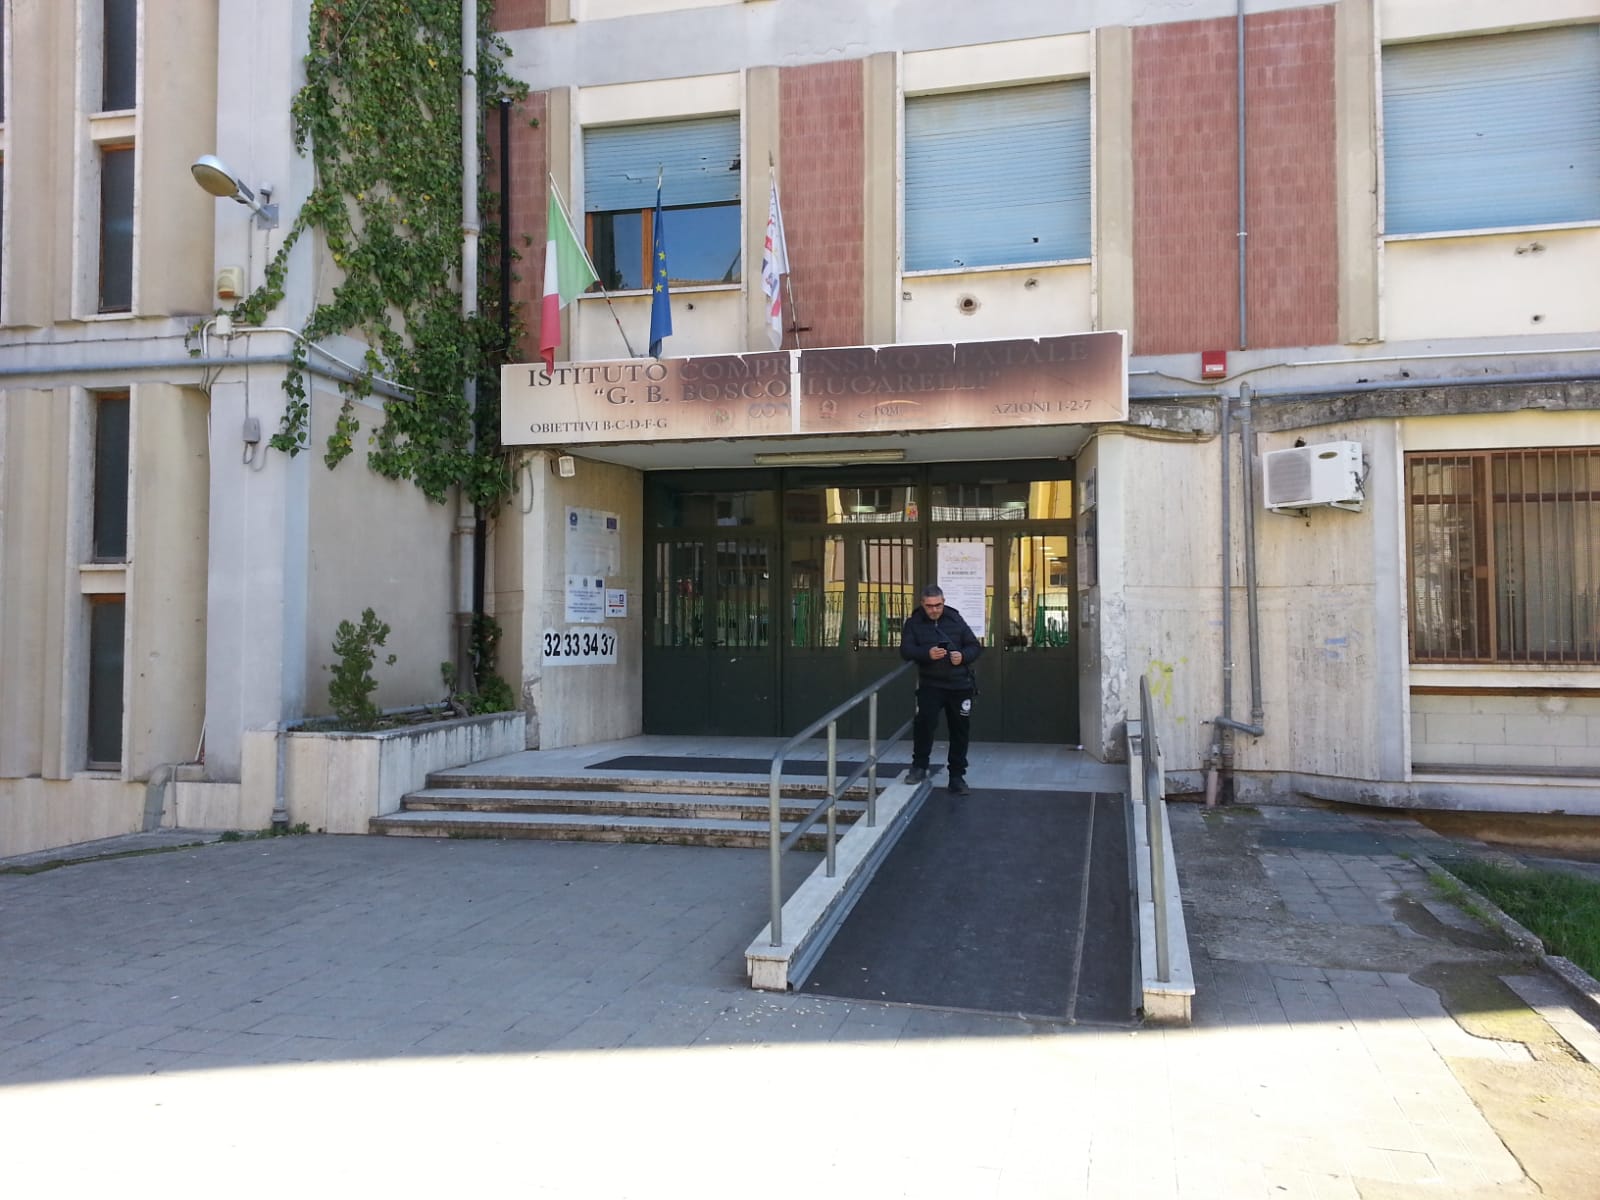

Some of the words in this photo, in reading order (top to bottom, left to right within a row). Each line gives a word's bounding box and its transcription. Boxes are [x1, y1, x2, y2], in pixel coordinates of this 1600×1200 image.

[528, 363, 668, 387] ISTITUTO
[680, 351, 921, 381] COMPRENSIVO
[935, 339, 1089, 369] STATALE
[647, 385, 669, 403] B.
[680, 379, 788, 402] BOSCO
[991, 401, 1050, 415] AZIONI
[1057, 399, 1092, 412] 1-2-7
[530, 421, 598, 433] OBIETTIVI
[544, 633, 560, 656] 32
[564, 633, 579, 656] 33
[583, 632, 598, 656] 34
[601, 633, 615, 656] 37
